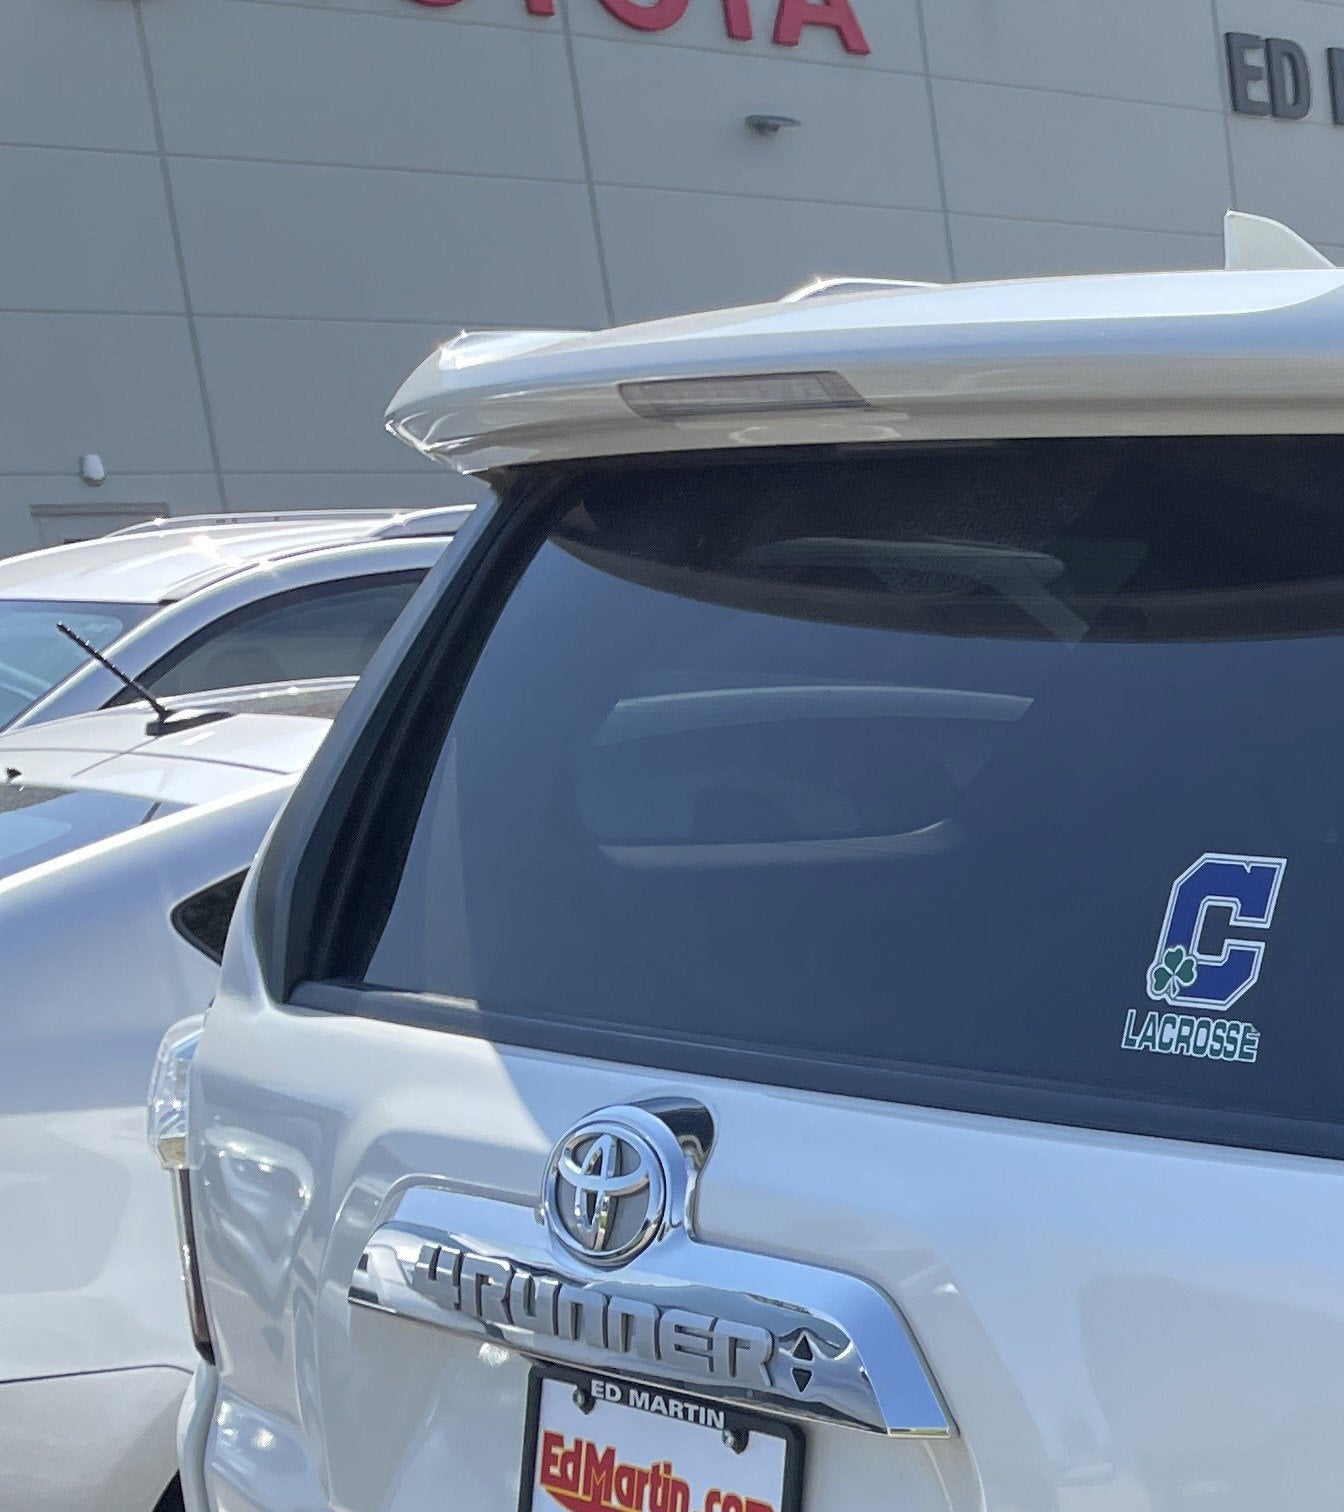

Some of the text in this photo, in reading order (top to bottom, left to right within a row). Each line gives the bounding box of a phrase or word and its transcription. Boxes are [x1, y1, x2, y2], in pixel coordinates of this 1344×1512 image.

[1225, 32, 1311, 120] ED
[1147, 853, 1287, 1011] C
[1121, 1009, 1261, 1062] LACROSSE
[411, 1243, 778, 1390] 4RUNNER
[591, 1379, 725, 1428] ED MARTIN
